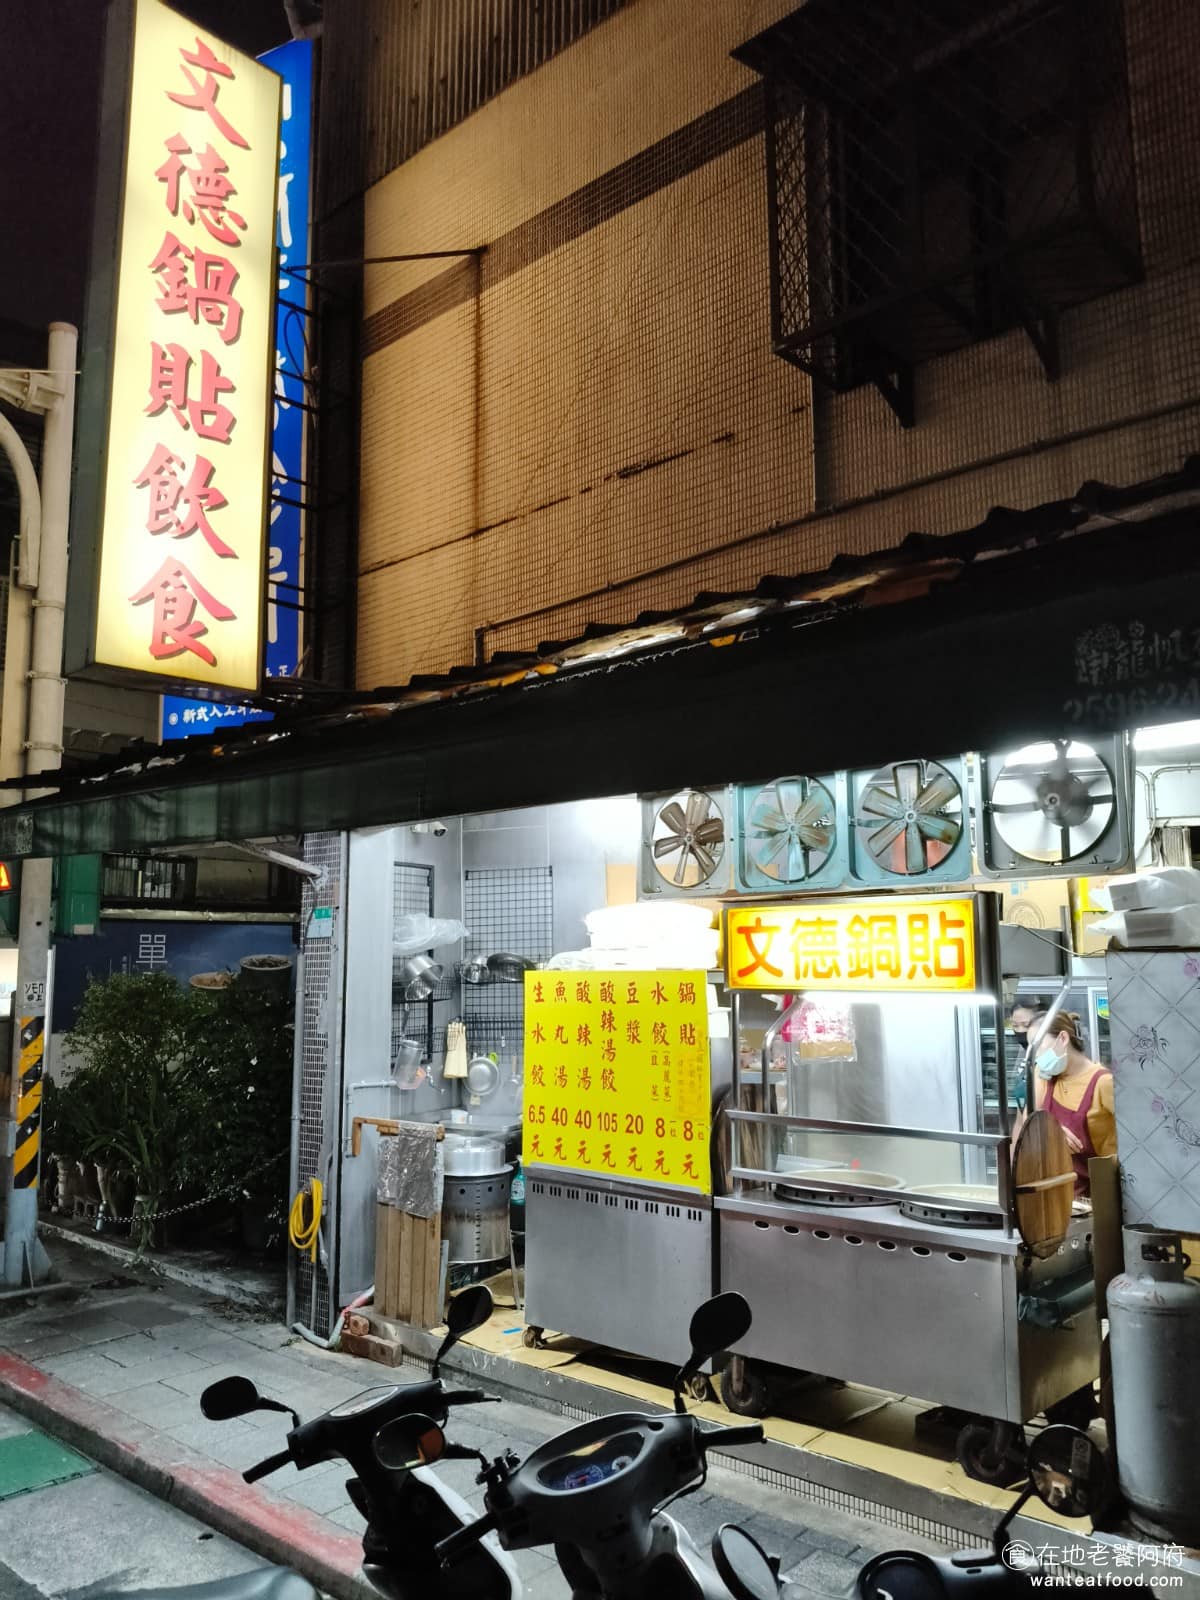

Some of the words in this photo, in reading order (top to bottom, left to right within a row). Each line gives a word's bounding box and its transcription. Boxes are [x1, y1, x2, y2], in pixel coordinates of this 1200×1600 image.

[128, 36, 251, 667] 文德鍋貼飲食
[736, 910, 966, 980] 文德鍋貼
[626, 982, 643, 1045] 豆漿
[650, 981, 670, 1046] 水餃
[677, 982, 696, 1047] 鍋貼
[531, 981, 546, 1087] 生水餃
[554, 981, 569, 1089] 魚丸湯
[576, 980, 592, 1091] 酸辣湯
[599, 980, 617, 1093] 酸辣湯餃
[528, 1104, 545, 1124] 6.5
[551, 1107, 568, 1127] 40
[574, 1109, 592, 1130] 40
[599, 1111, 618, 1133] 105
[625, 1114, 644, 1135] 20
[655, 1117, 665, 1138] 8
[683, 1120, 694, 1141] 8
[531, 1134, 544, 1158] 元
[554, 1137, 567, 1161] 元
[576, 1140, 591, 1164] 元
[601, 1143, 616, 1168] 元
[627, 1146, 643, 1172] 元
[653, 1150, 670, 1176] 元
[682, 1153, 700, 1180] 元
